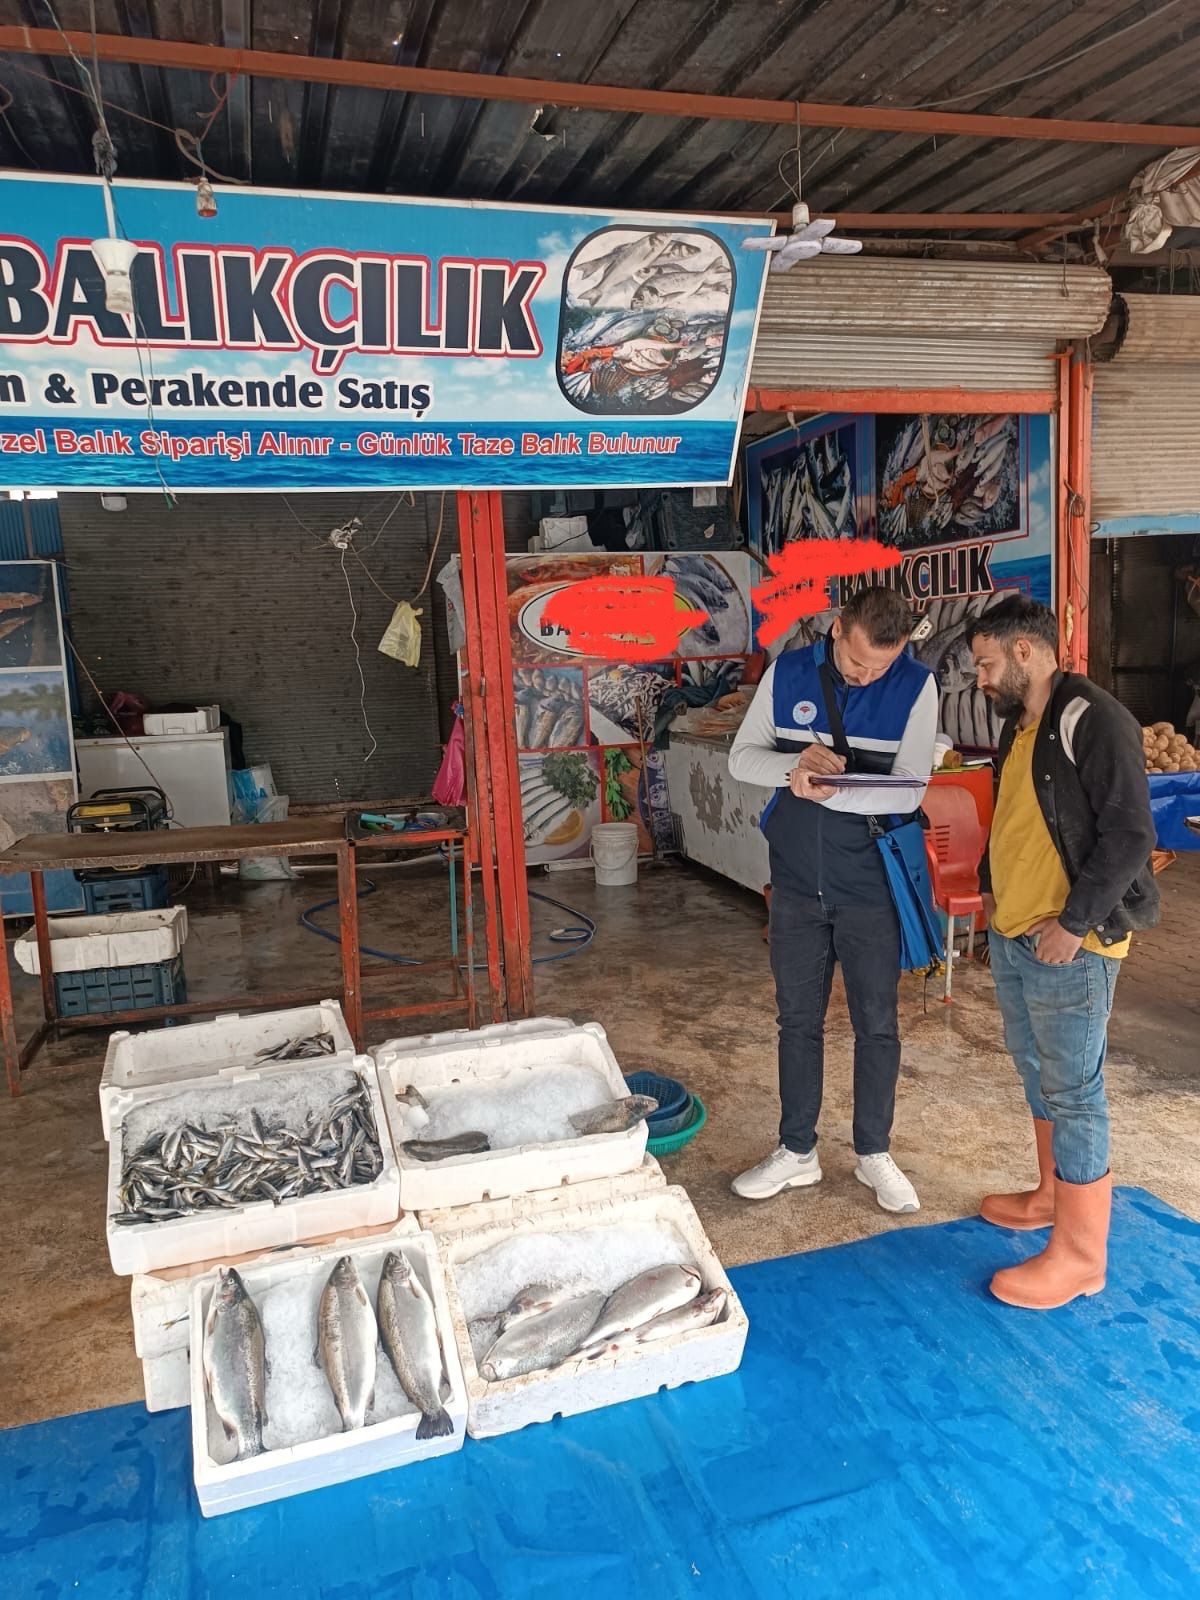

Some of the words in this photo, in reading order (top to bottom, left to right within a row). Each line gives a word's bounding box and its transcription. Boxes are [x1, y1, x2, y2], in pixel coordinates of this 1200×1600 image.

[0, 237, 544, 373] BALIKÇILIK
[45, 373, 76, 404] &
[91, 373, 323, 407] Perakende
[338, 377, 431, 418] Satış
[0, 429, 46, 454] zel
[54, 430, 134, 455] Balık
[140, 430, 250, 461] Siparişi
[257, 432, 334, 456] Alınır
[357, 432, 452, 456] Günlük
[458, 432, 515, 456] Taze
[521, 432, 581, 456] Balık
[588, 431, 682, 455] Bulunur
